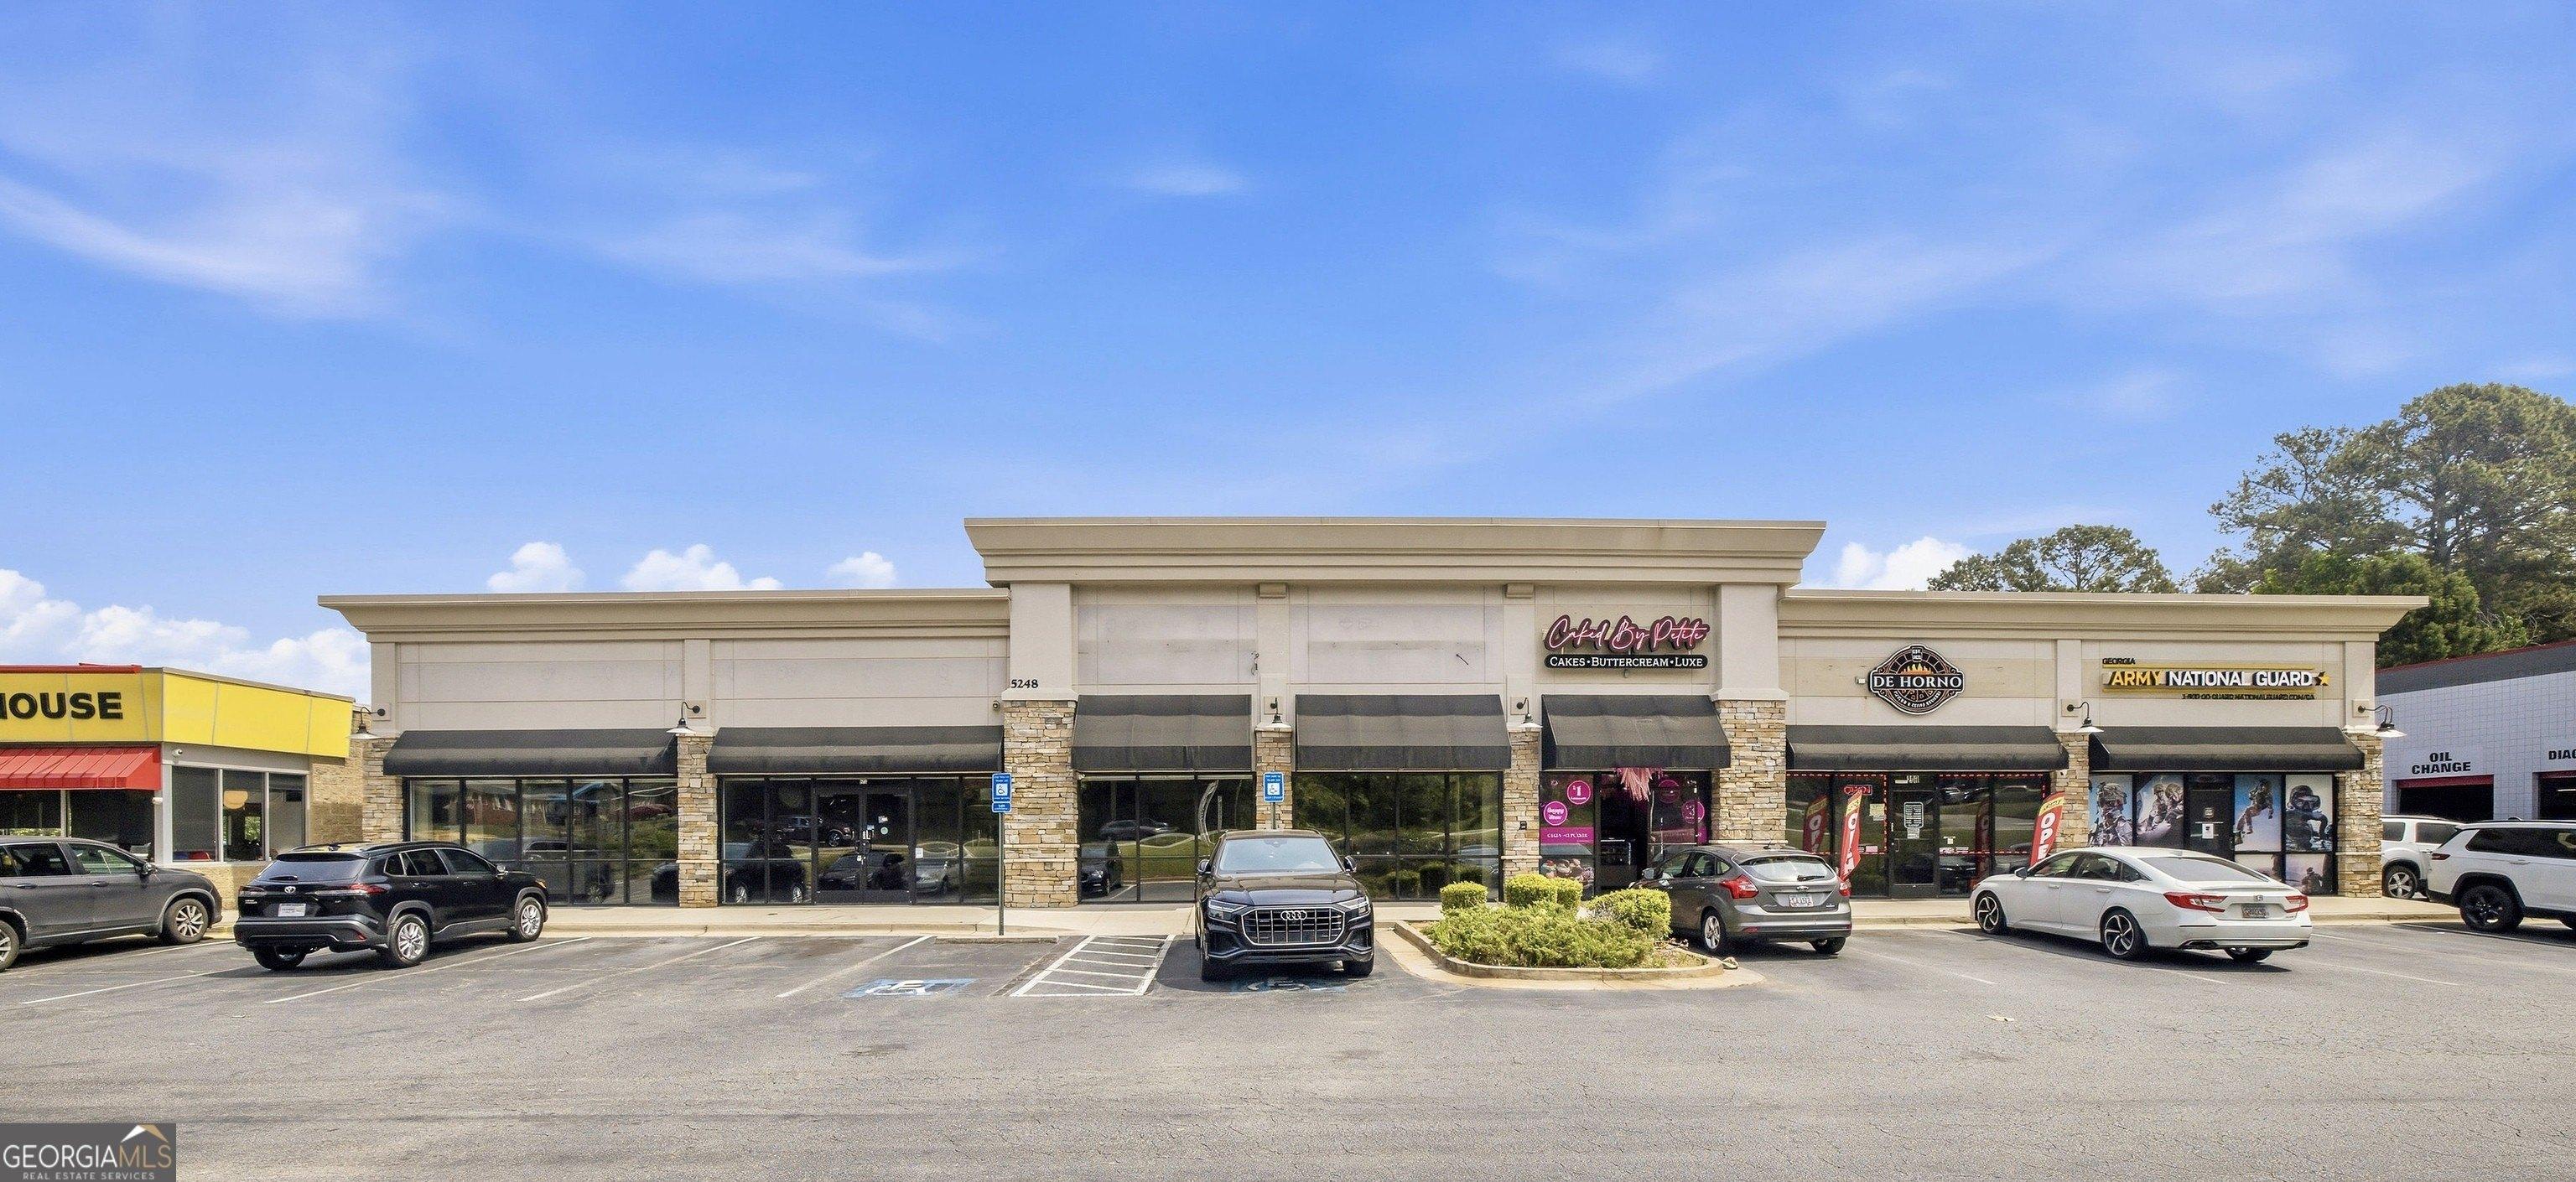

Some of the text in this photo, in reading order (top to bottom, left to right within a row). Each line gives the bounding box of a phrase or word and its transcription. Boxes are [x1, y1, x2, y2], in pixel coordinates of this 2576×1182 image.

[1547, 617, 1708, 651] Caked By Petite
[1675, 656, 1704, 667] LUXE
[2101, 657, 2137, 666] GEORGIA
[1010, 679, 1039, 689] 5248
[1873, 676, 1962, 688] DE HORNO
[2109, 671, 2314, 687] ARMY NATIONAL GUARD
[2429, 751, 2453, 763] OIL
[2412, 761, 2471, 775] CHANGE
[2038, 812, 2056, 860] OPE
